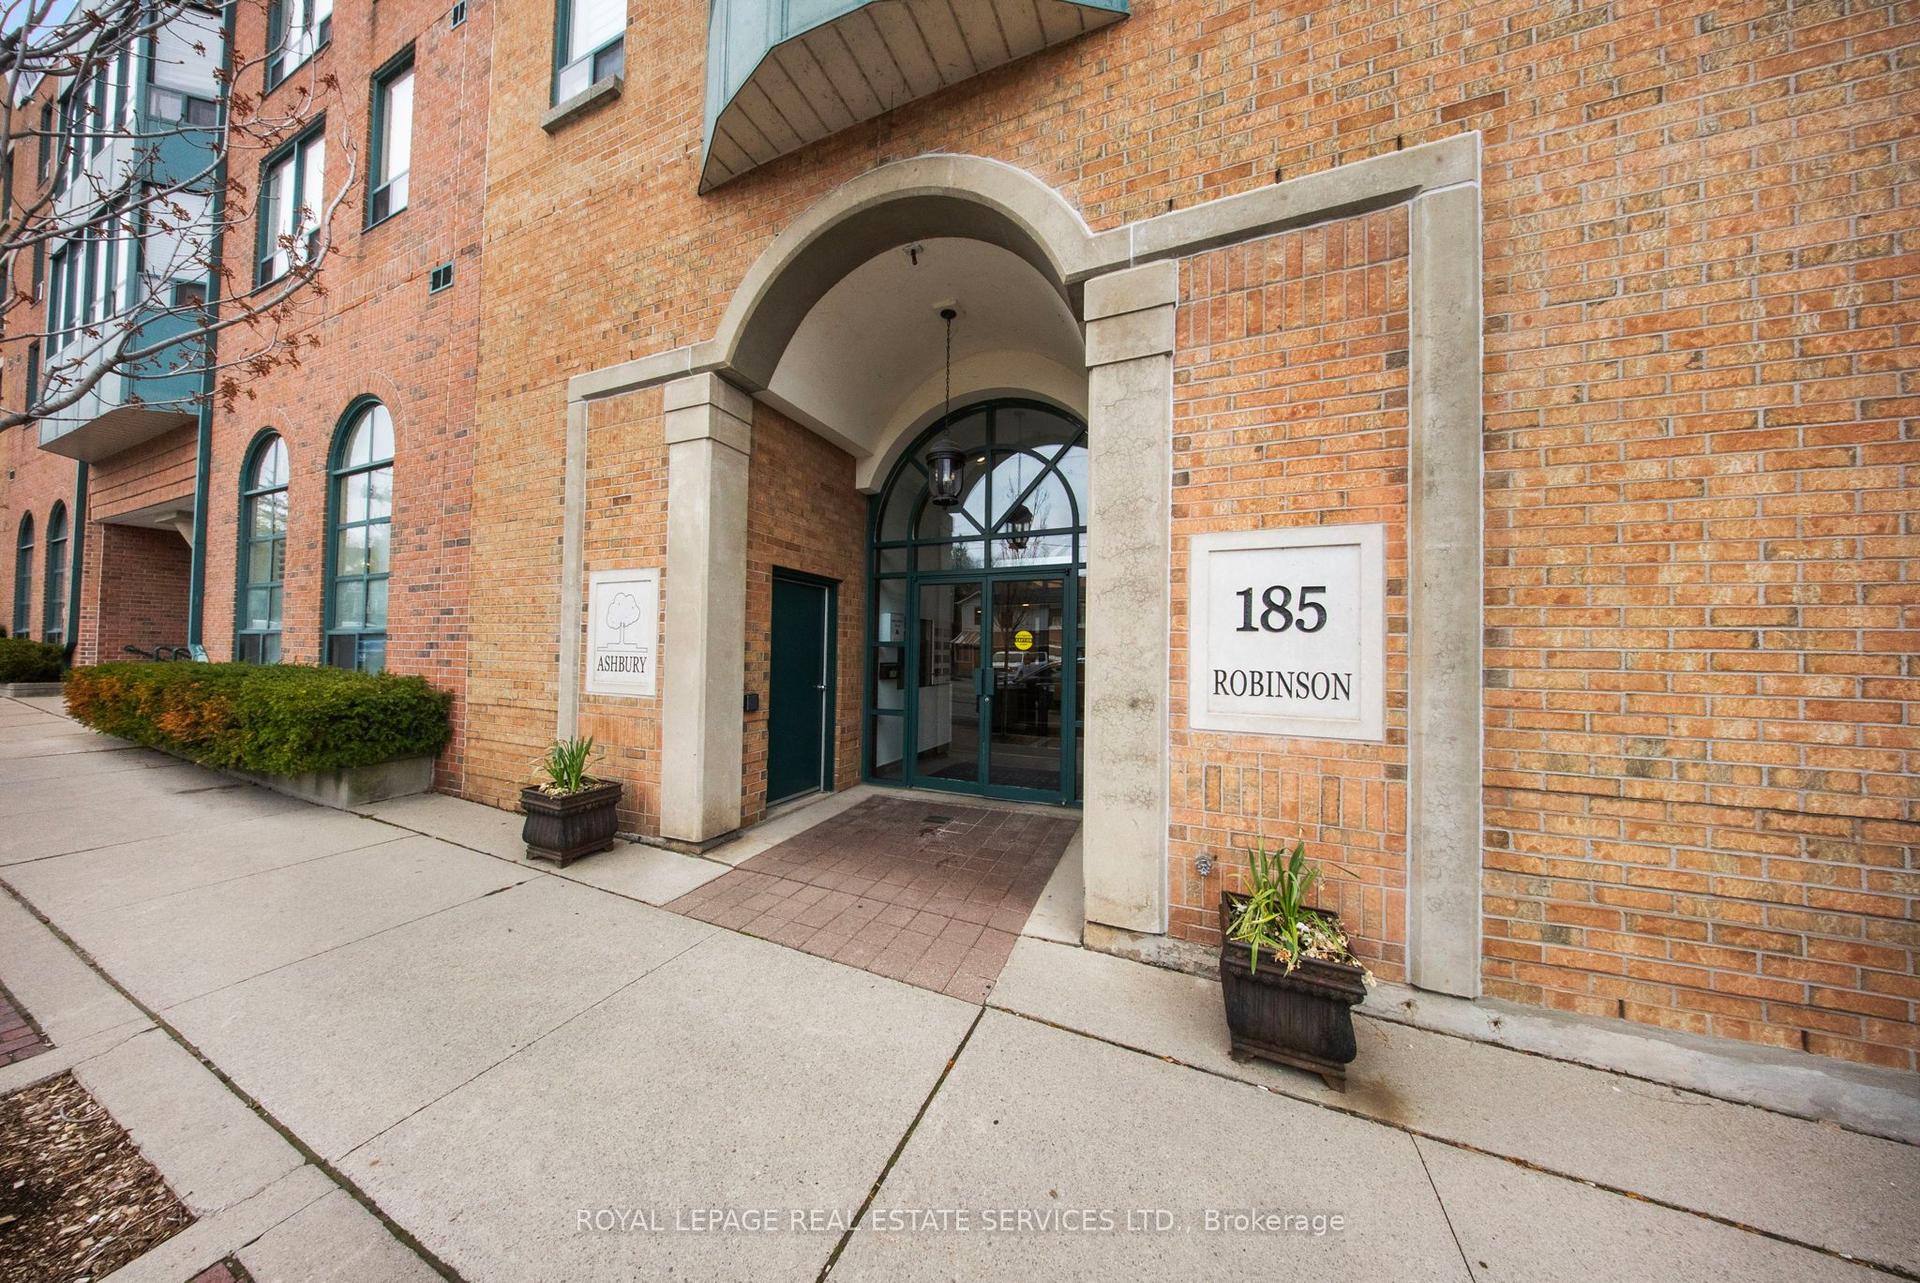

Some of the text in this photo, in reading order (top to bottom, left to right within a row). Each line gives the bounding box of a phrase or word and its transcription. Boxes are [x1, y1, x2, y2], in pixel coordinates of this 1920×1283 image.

[1236, 585, 1327, 633] 185
[597, 655, 647, 673] ASHBURY
[1213, 669, 1352, 700] ROBINSON
